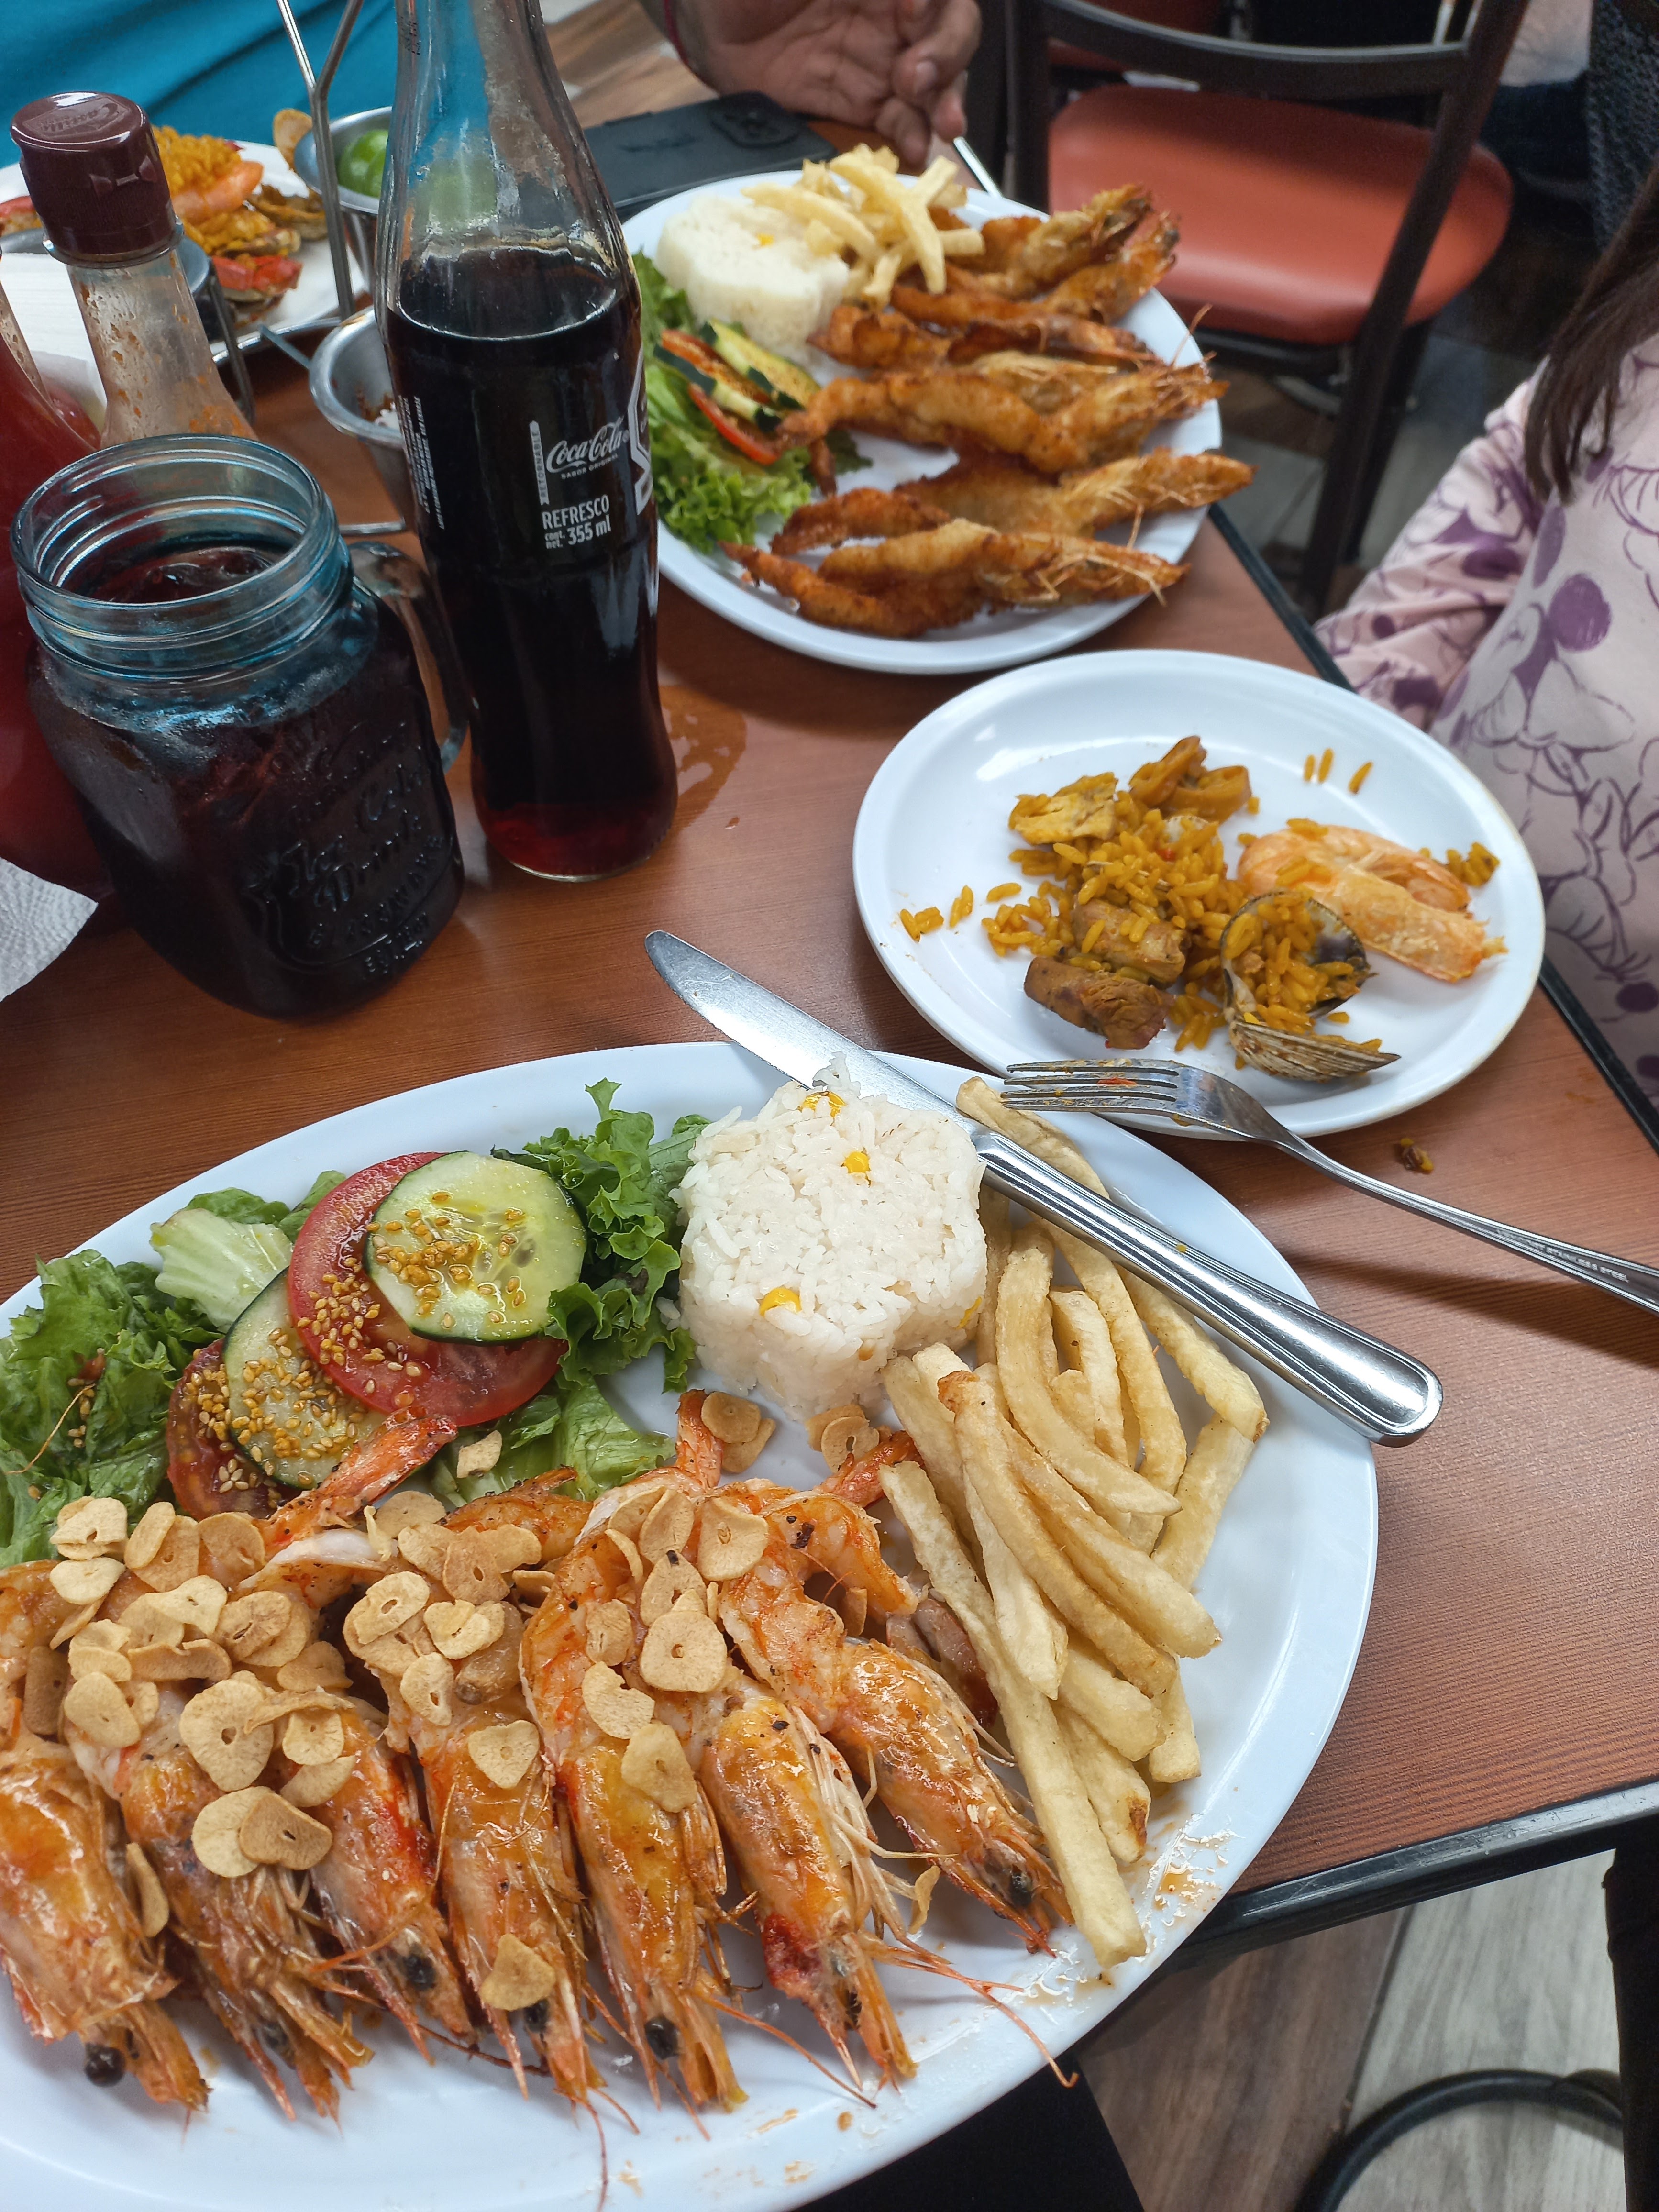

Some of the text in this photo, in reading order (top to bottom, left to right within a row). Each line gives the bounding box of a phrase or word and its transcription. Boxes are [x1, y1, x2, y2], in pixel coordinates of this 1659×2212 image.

[561, 465, 587, 480] SABOR
[542, 494, 610, 530] REFRESCO
[567, 522, 593, 545] 355
[596, 514, 612, 537] ml
[1599, 1266, 1629, 1283] STEEL
